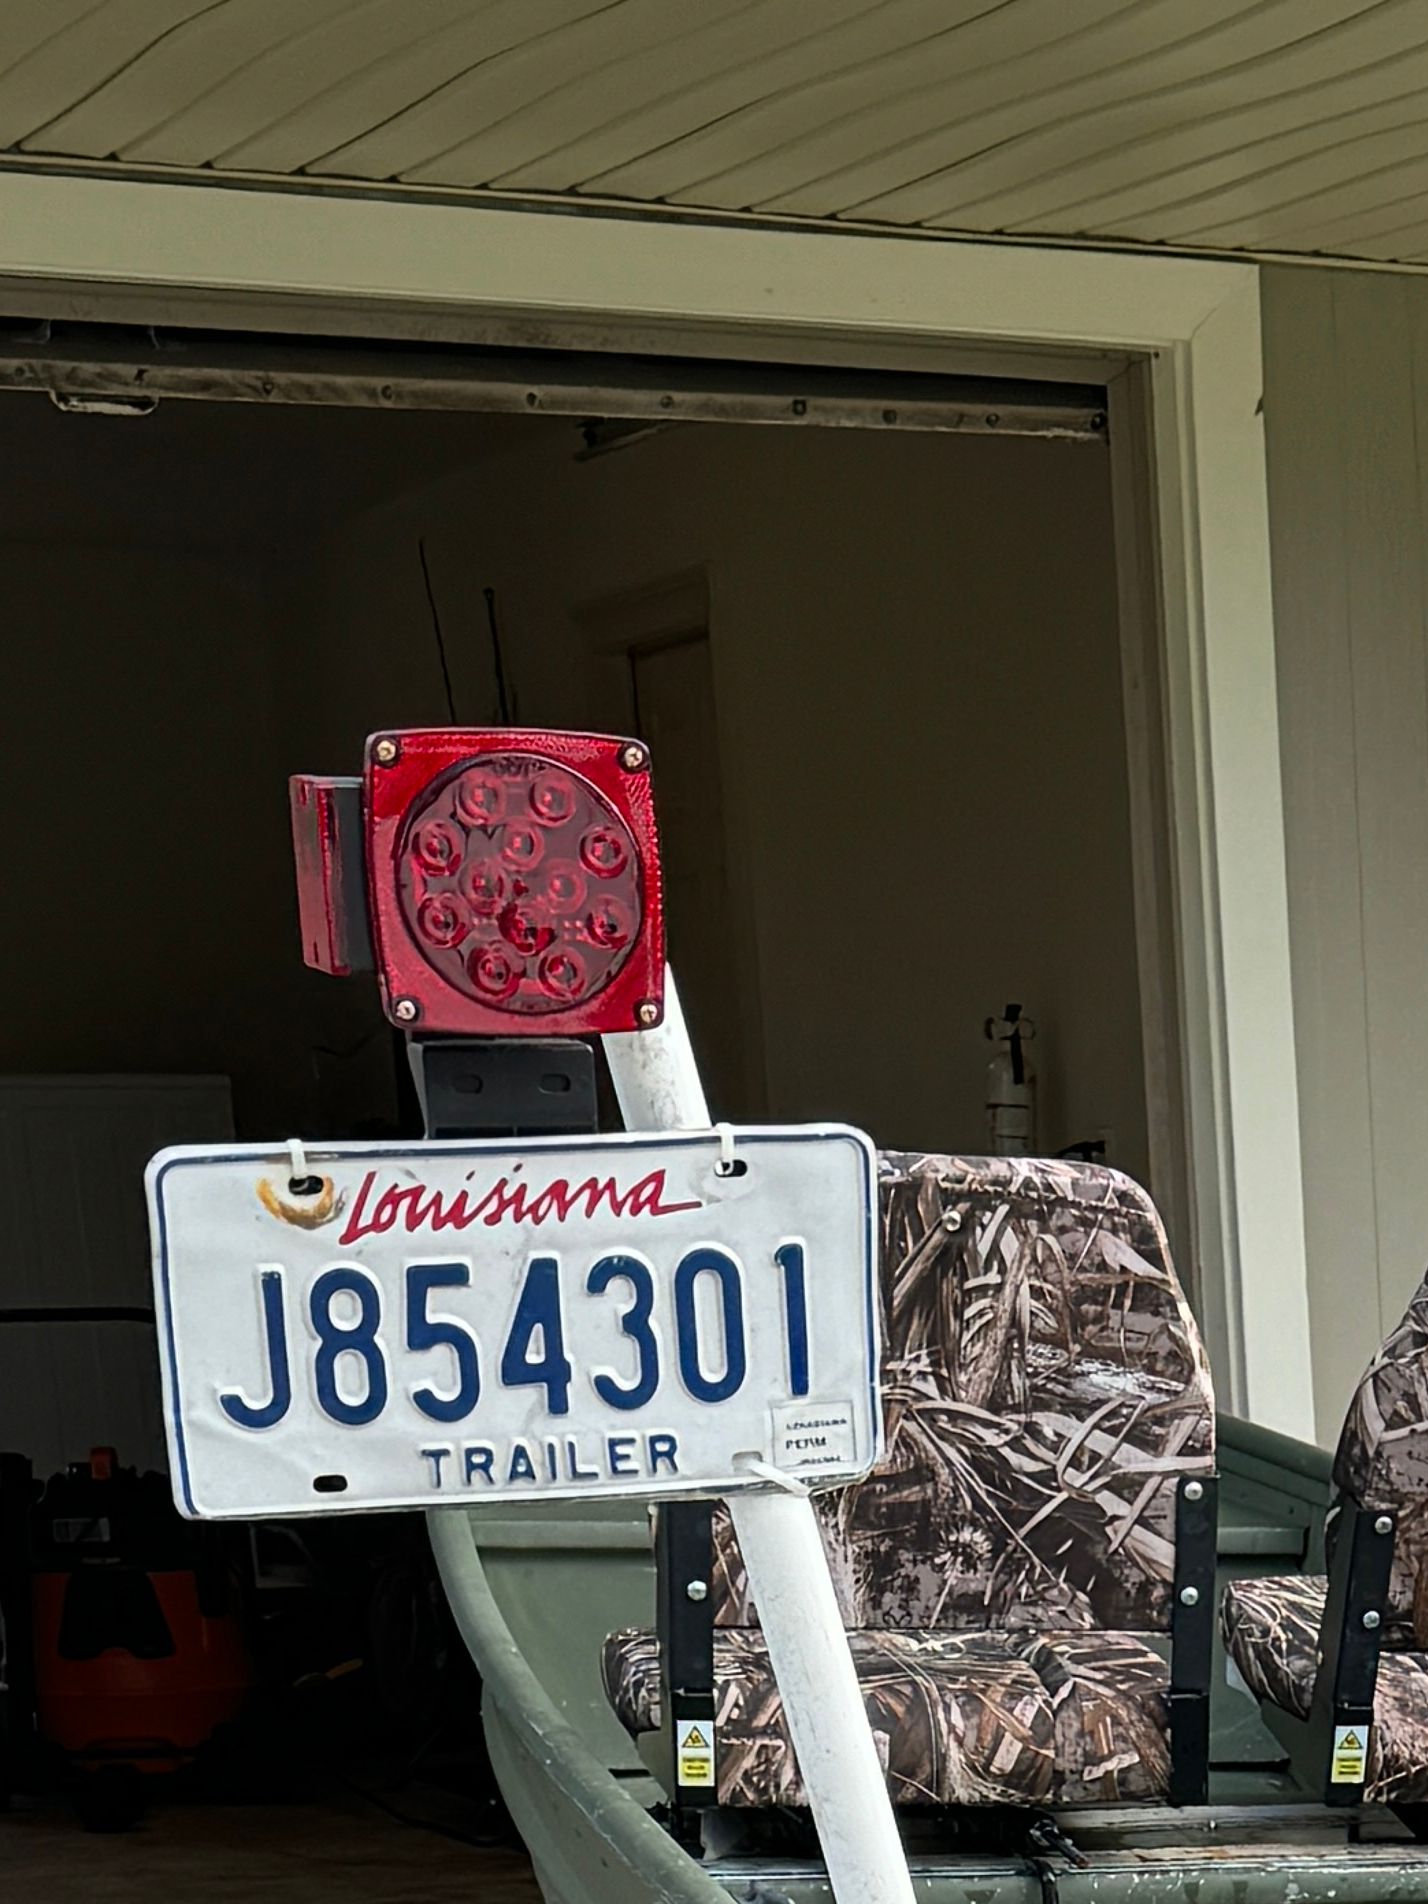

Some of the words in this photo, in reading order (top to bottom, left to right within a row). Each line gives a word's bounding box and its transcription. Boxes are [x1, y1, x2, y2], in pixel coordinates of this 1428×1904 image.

[339, 1163, 703, 1246] Louisiana
[219, 1243, 811, 1430] J854301
[421, 1433, 679, 1489] TRAILER
